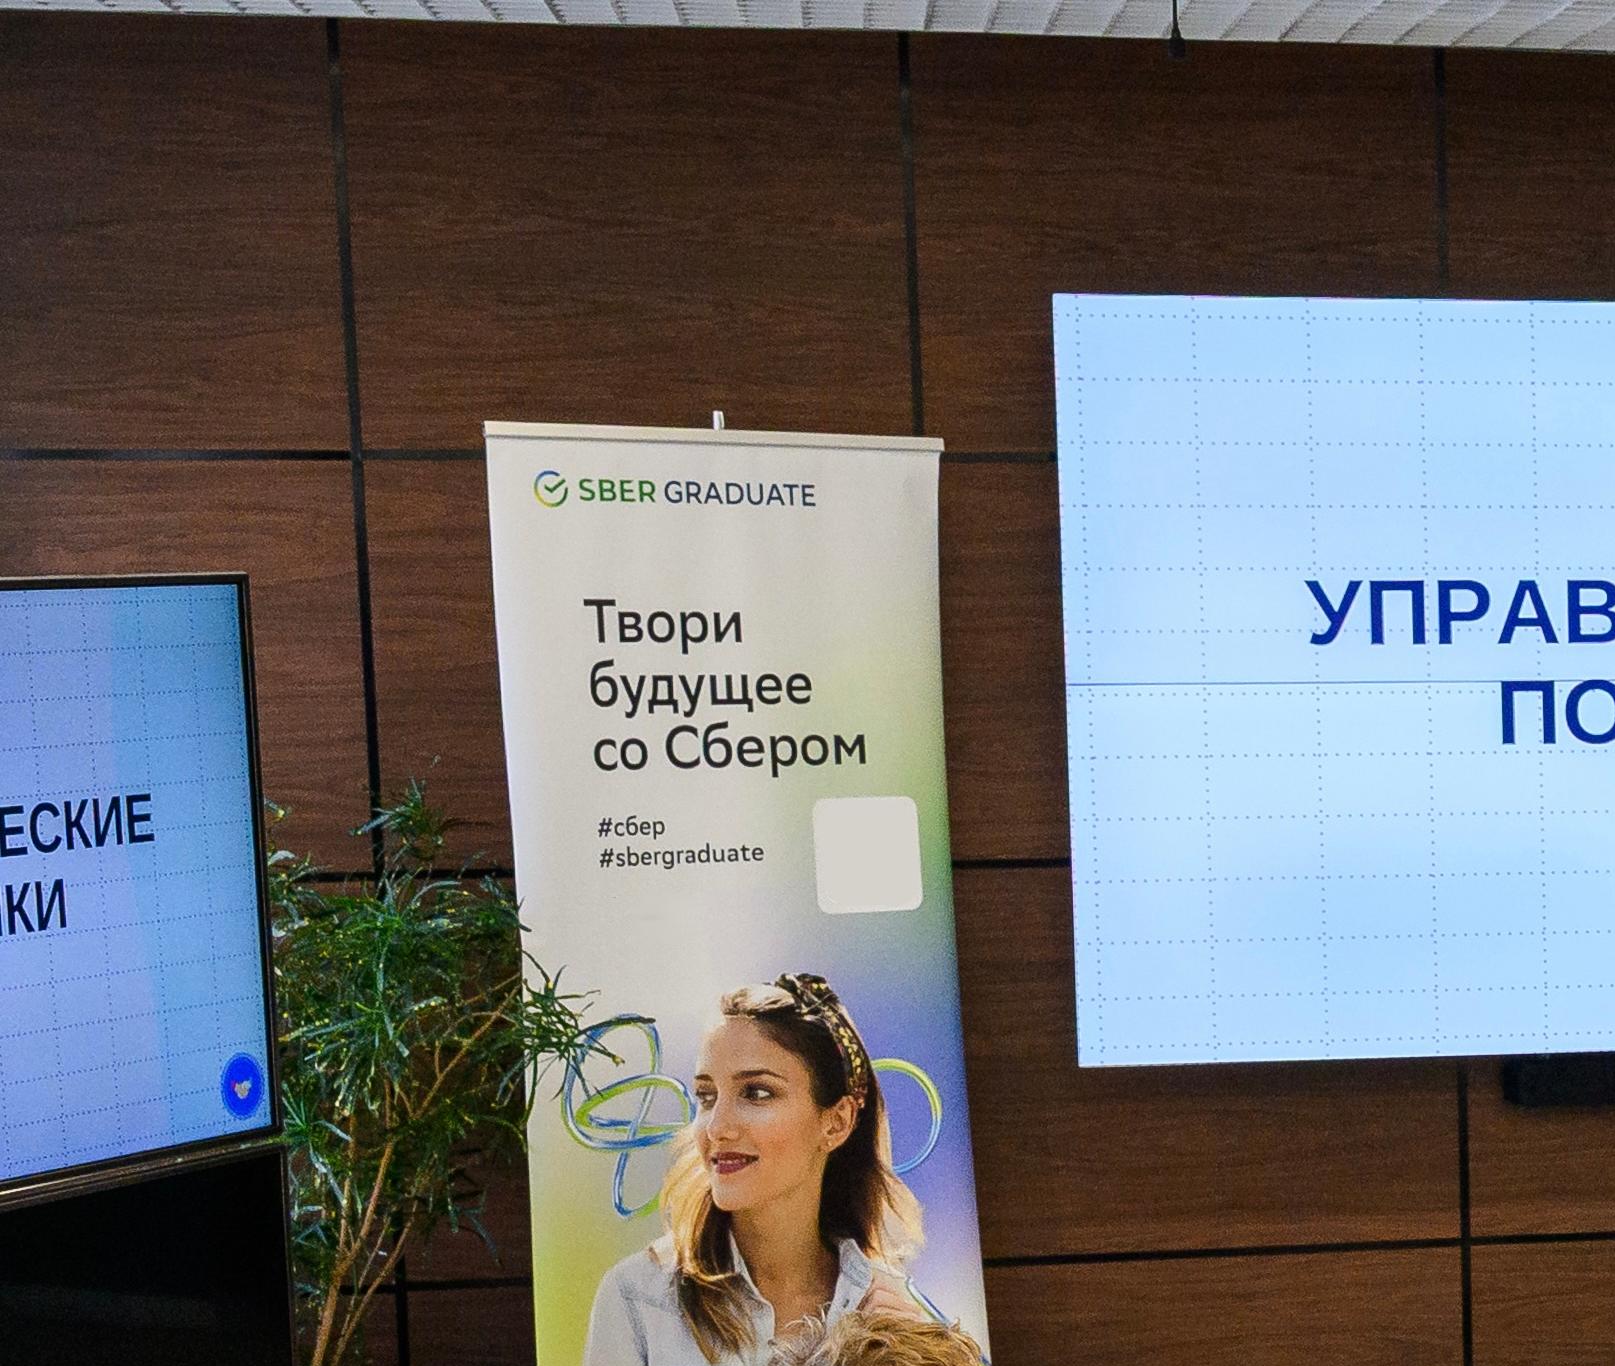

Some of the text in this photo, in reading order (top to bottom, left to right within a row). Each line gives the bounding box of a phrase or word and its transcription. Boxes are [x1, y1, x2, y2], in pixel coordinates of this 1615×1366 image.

[579, 478, 816, 507] SBER GRADUATE
[583, 599, 744, 654] Твори
[590, 660, 813, 718] будущее
[593, 722, 867, 778] со Сбером
[0, 793, 155, 857] ЕСКИЕ
[598, 816, 666, 840] #сбер
[599, 844, 764, 869] #sbergraduate
[0, 878, 67, 937] КИ
